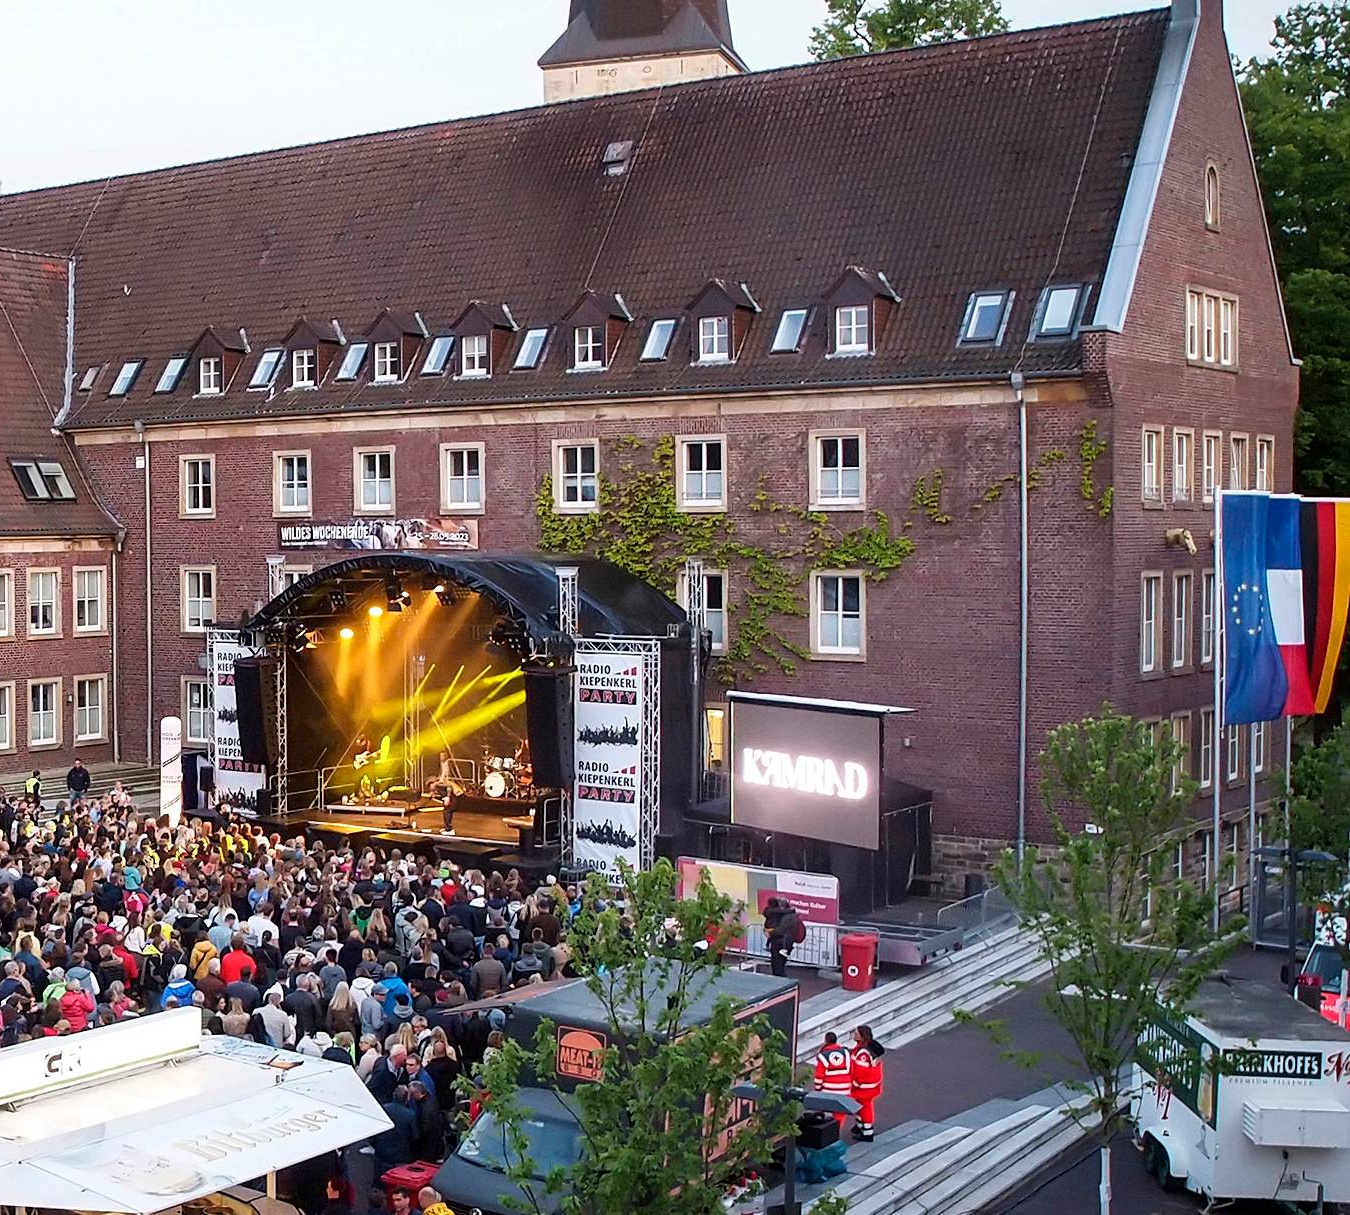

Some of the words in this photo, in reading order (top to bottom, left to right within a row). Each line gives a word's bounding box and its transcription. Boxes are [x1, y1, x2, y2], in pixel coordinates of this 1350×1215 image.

[281, 526, 311, 540] WILDES
[312, 526, 369, 540] WOCHENENDE
[580, 663, 611, 675] RADIO
[579, 676, 637, 689] KIEPENKERL
[580, 688, 636, 704] PARTY
[219, 759, 261, 772] PARTY
[578, 760, 609, 773] RADIO
[742, 747, 868, 800] KAMRAD
[578, 773, 636, 788] KIEPENKERL
[579, 785, 635, 803] PARTY
[576, 858, 607, 871] RADIO
